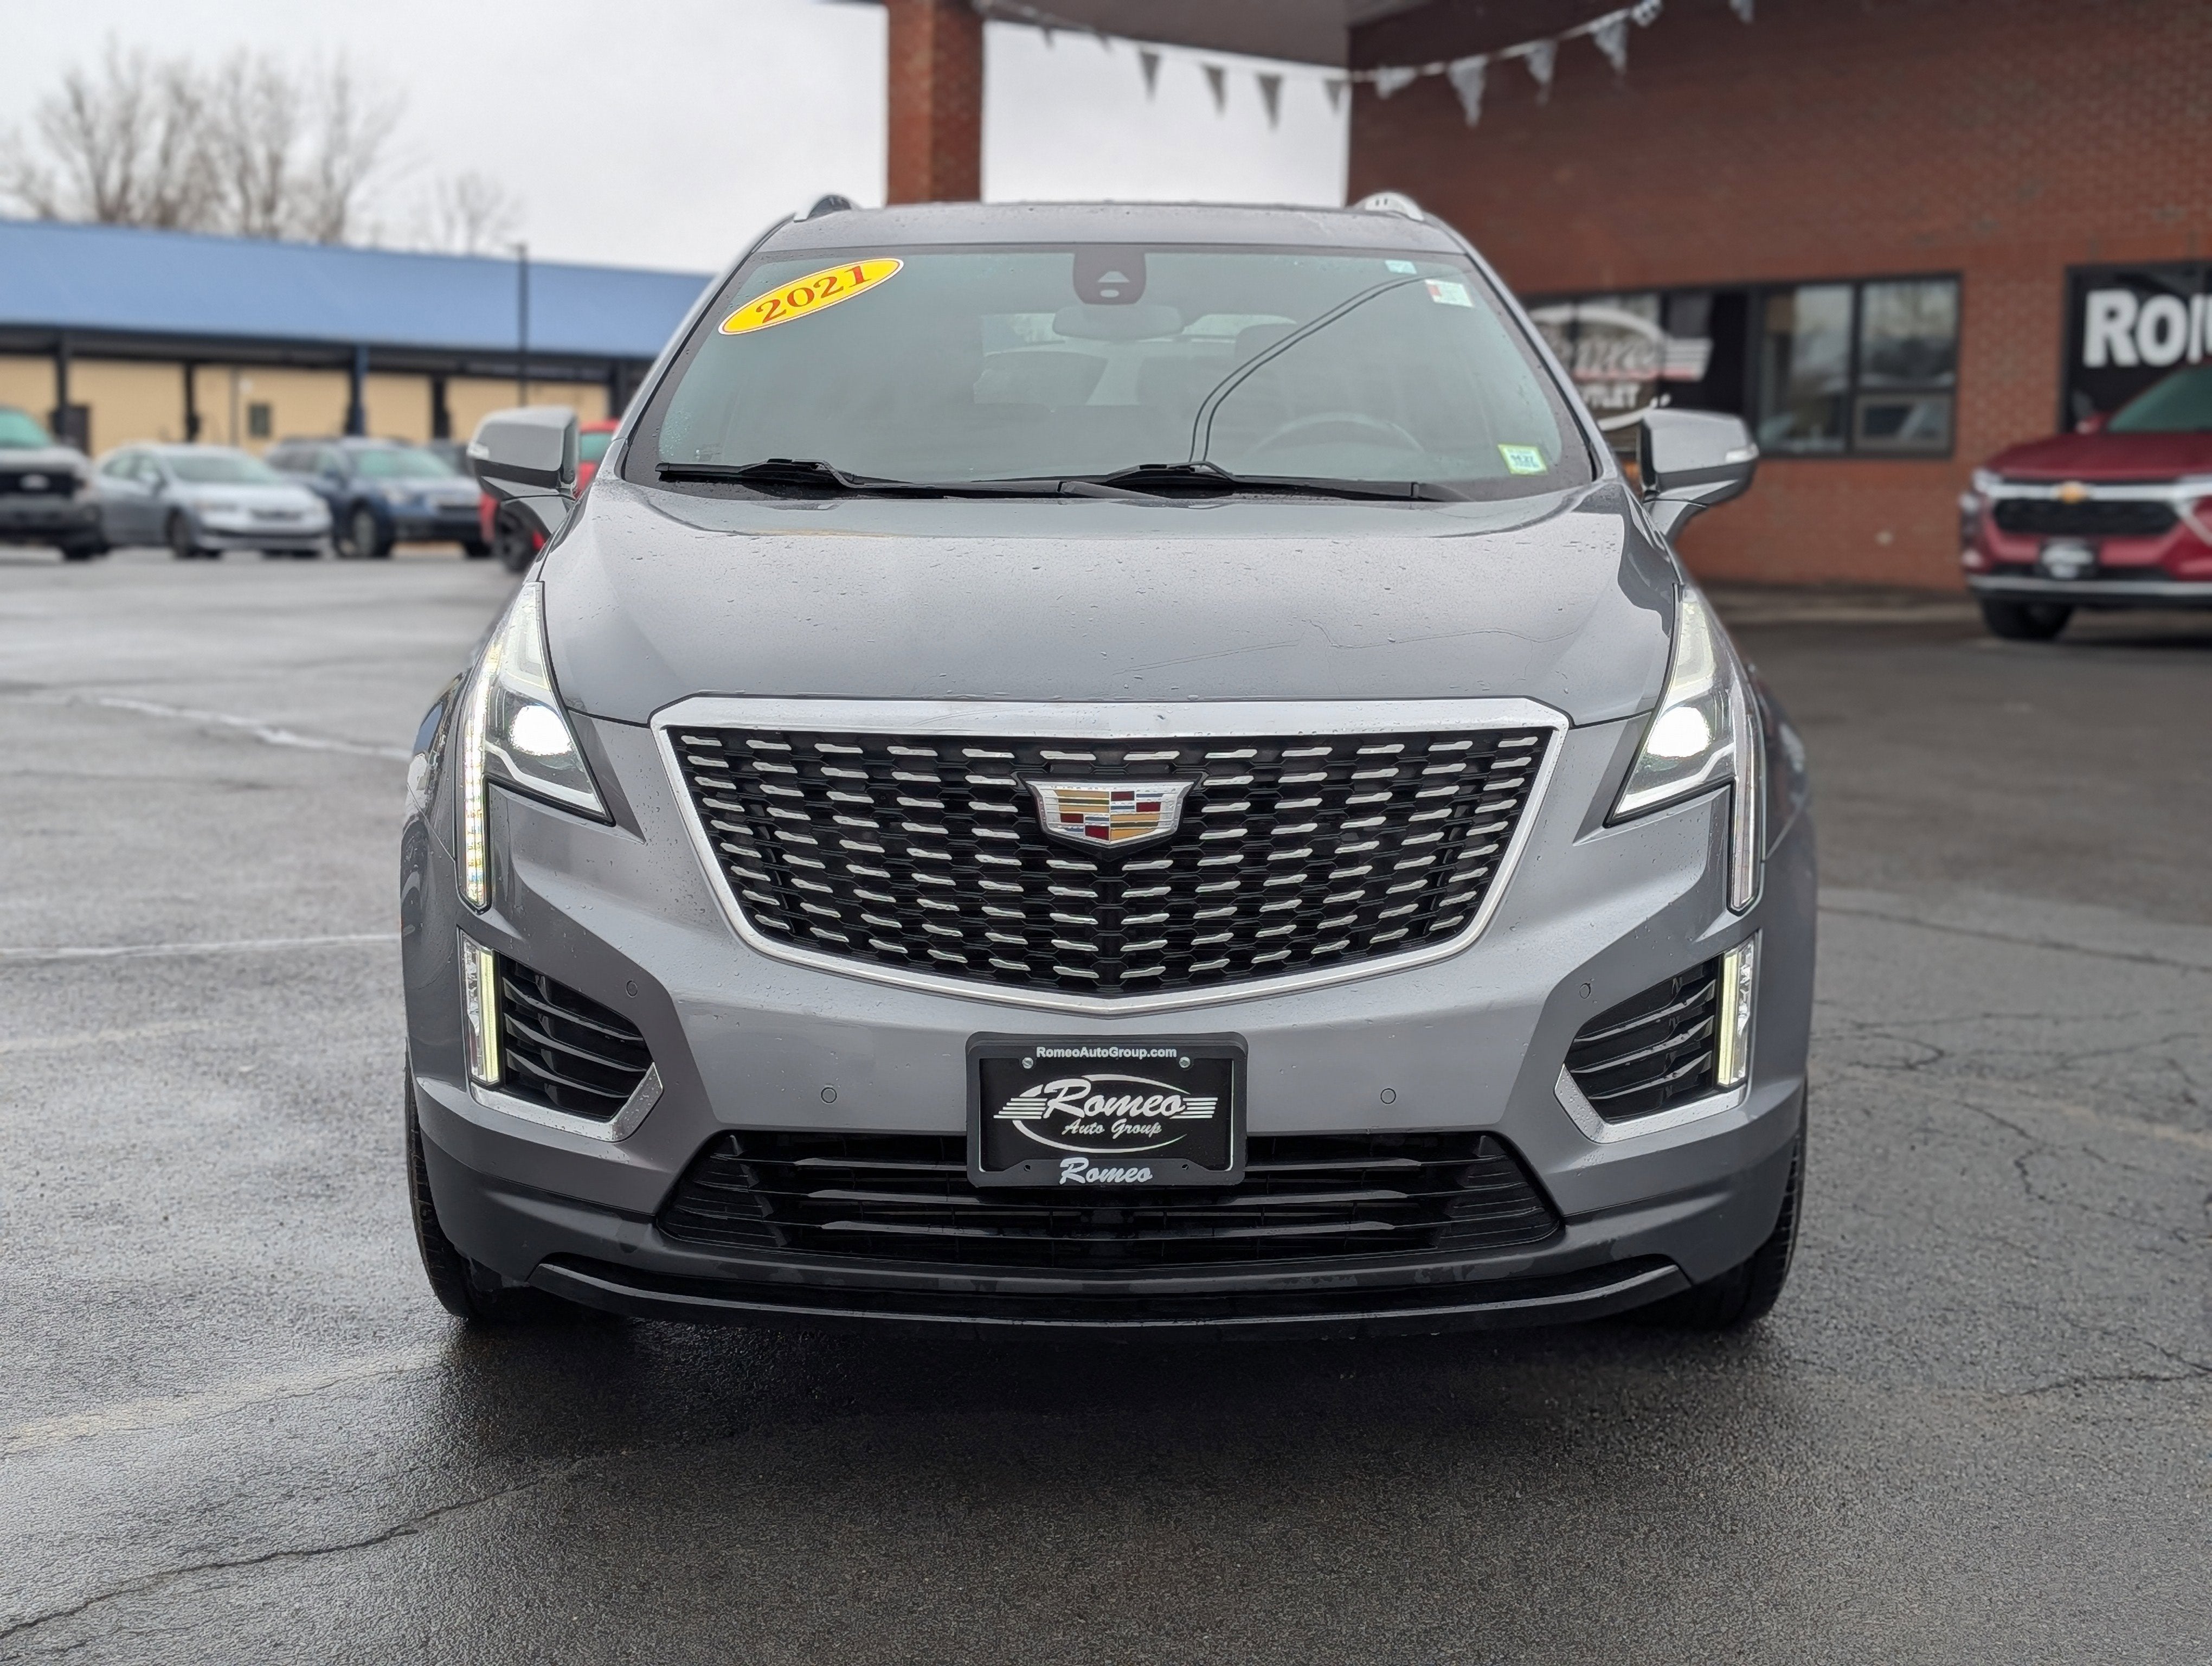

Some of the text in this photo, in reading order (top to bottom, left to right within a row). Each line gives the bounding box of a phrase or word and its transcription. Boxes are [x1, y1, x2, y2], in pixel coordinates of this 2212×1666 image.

[756, 266, 872, 323] 2021
[1036, 1046, 1177, 1060] RomeoAutoGroup.com
[1043, 1078, 1185, 1118] Romeo
[1062, 1118, 1162, 1139] Auto Group
[1059, 1157, 1153, 1184] Romeo
